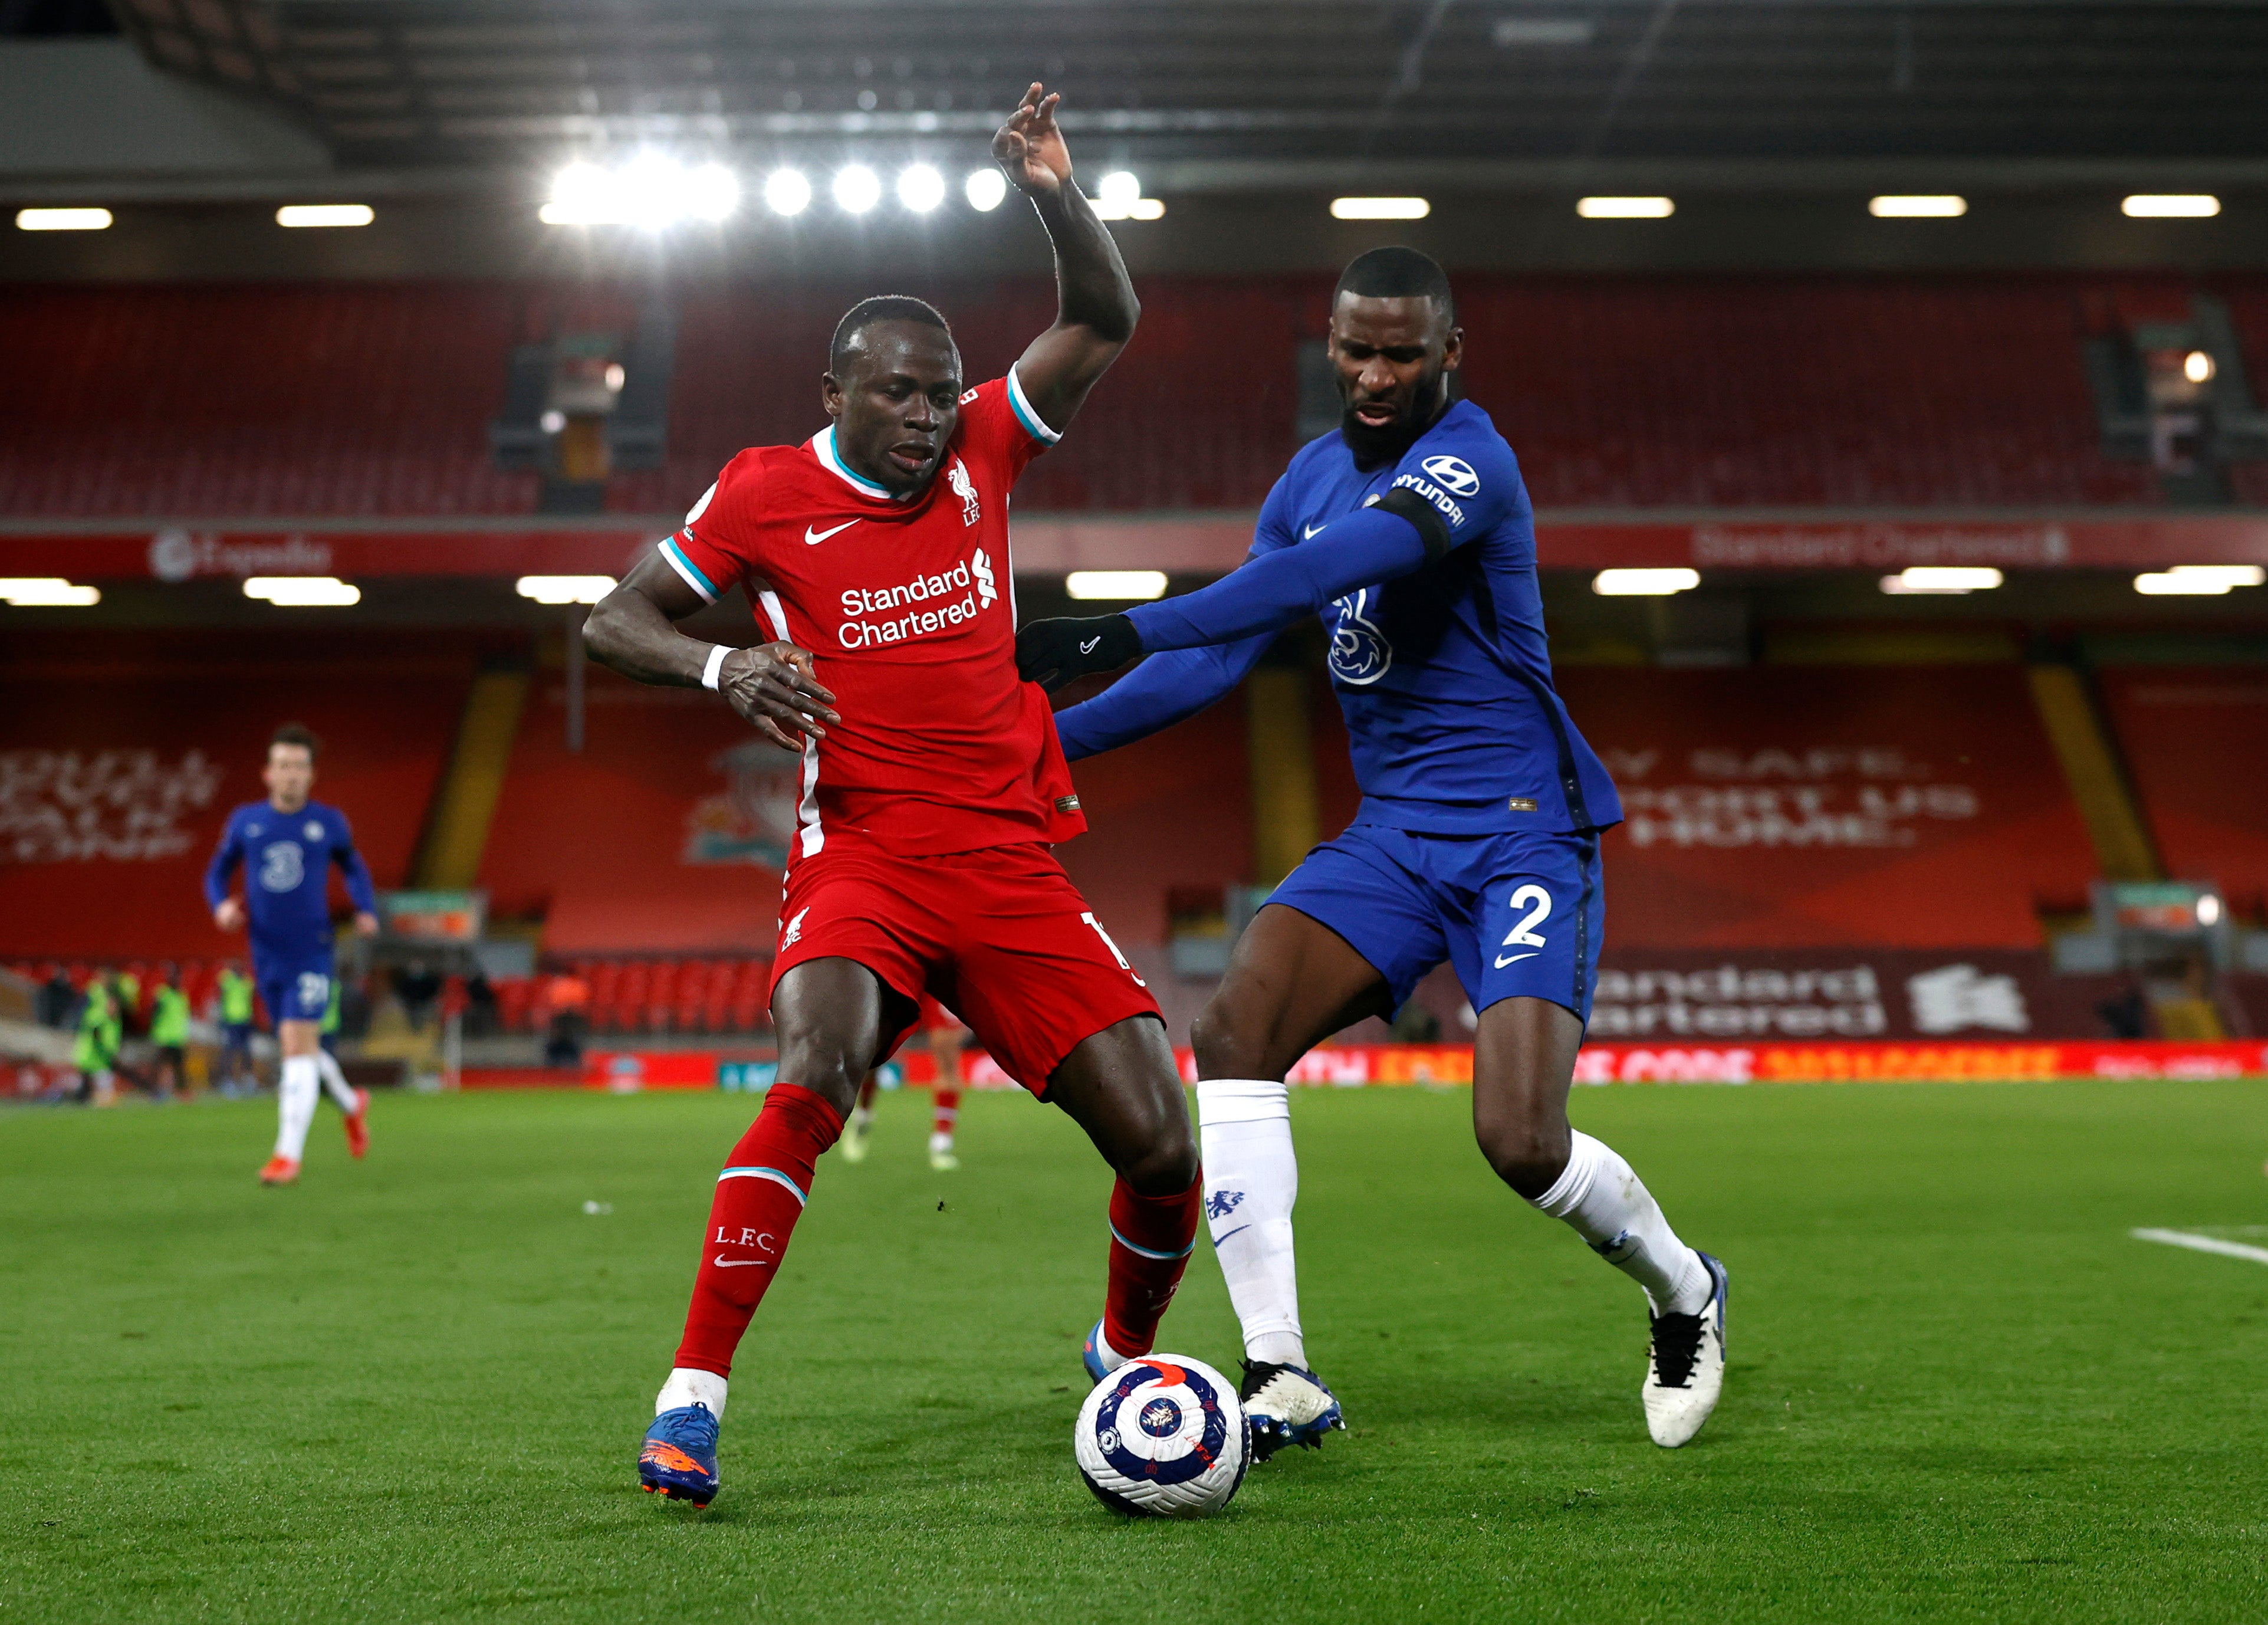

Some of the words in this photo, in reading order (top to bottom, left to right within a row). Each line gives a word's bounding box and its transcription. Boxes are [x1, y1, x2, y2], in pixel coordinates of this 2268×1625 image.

[1392, 474, 1466, 527] HYUNDAI
[840, 560, 971, 616] Standard
[837, 592, 977, 649] Chartered
[1502, 884, 1552, 948] 2
[1597, 964, 1878, 1002] andard
[715, 1227, 775, 1254] L.F.C.
